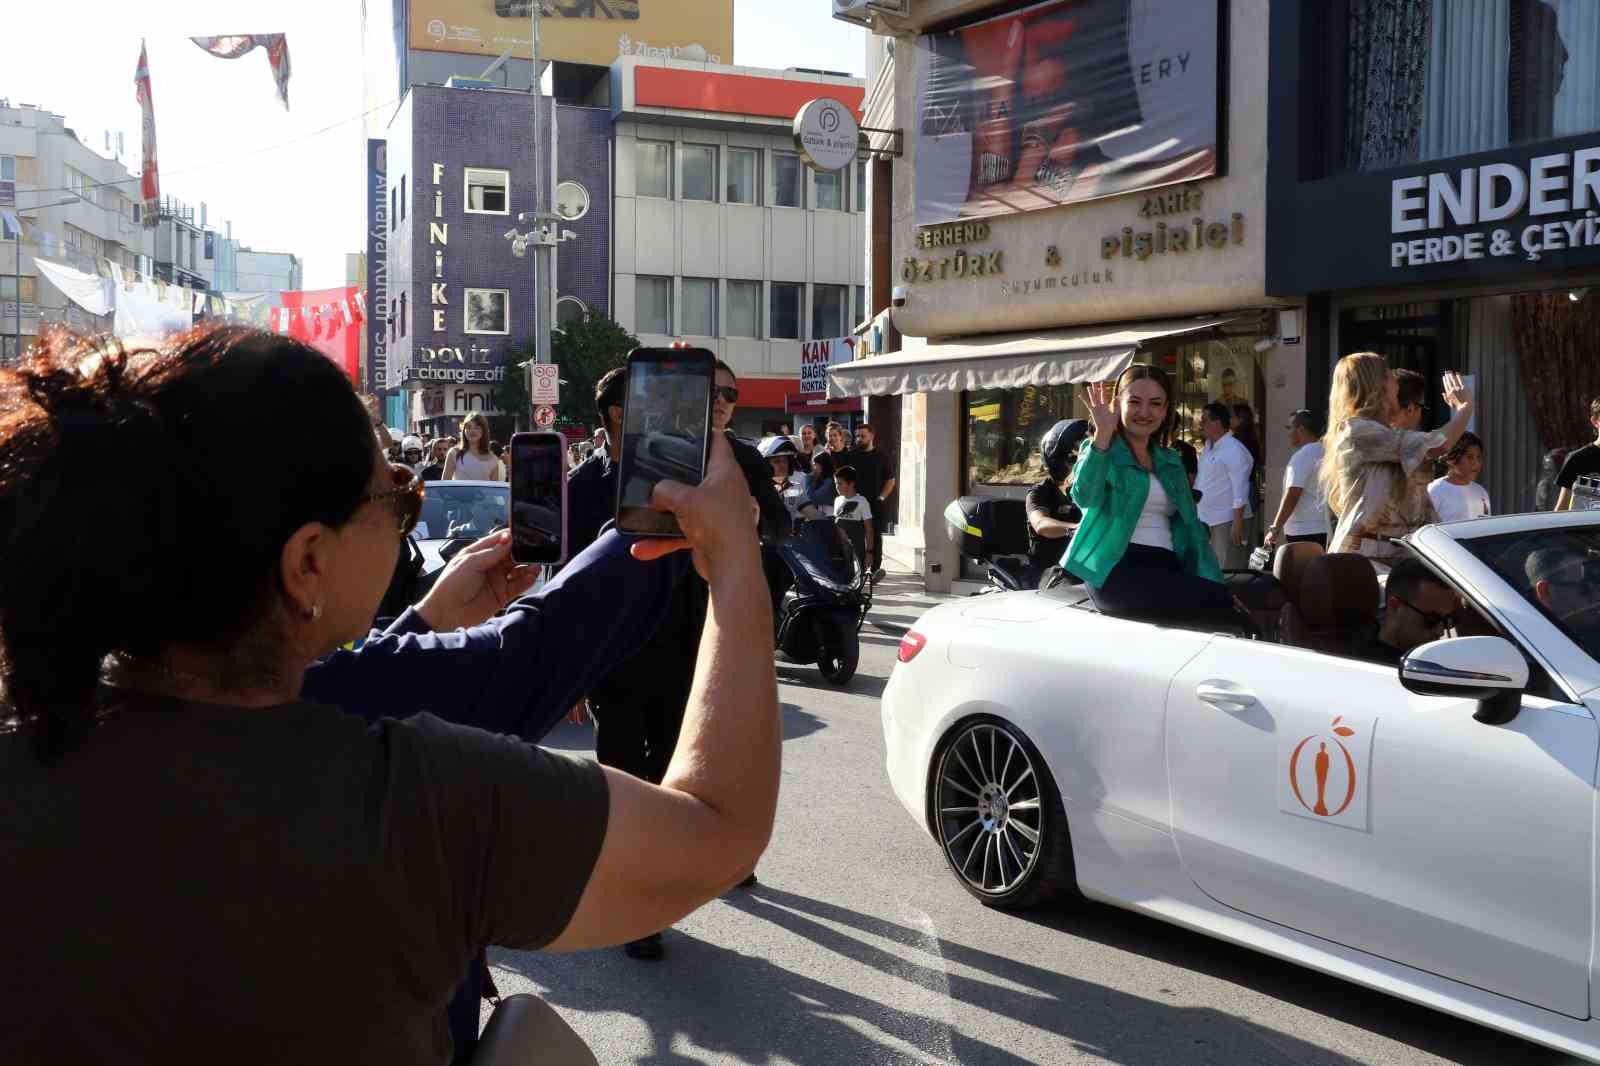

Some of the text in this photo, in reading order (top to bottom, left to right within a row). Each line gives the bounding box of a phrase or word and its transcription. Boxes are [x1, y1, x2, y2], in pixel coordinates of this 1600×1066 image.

[1392, 146, 1600, 234] ENDER
[1392, 232, 1485, 268] PERDE
[1489, 228, 1515, 257] &
[902, 249, 1003, 283] ÖZTÜRK
[1046, 245, 1062, 267] &
[802, 341, 830, 364] KAN
[418, 363, 505, 383] change off
[801, 380, 827, 392] NOKTAS
